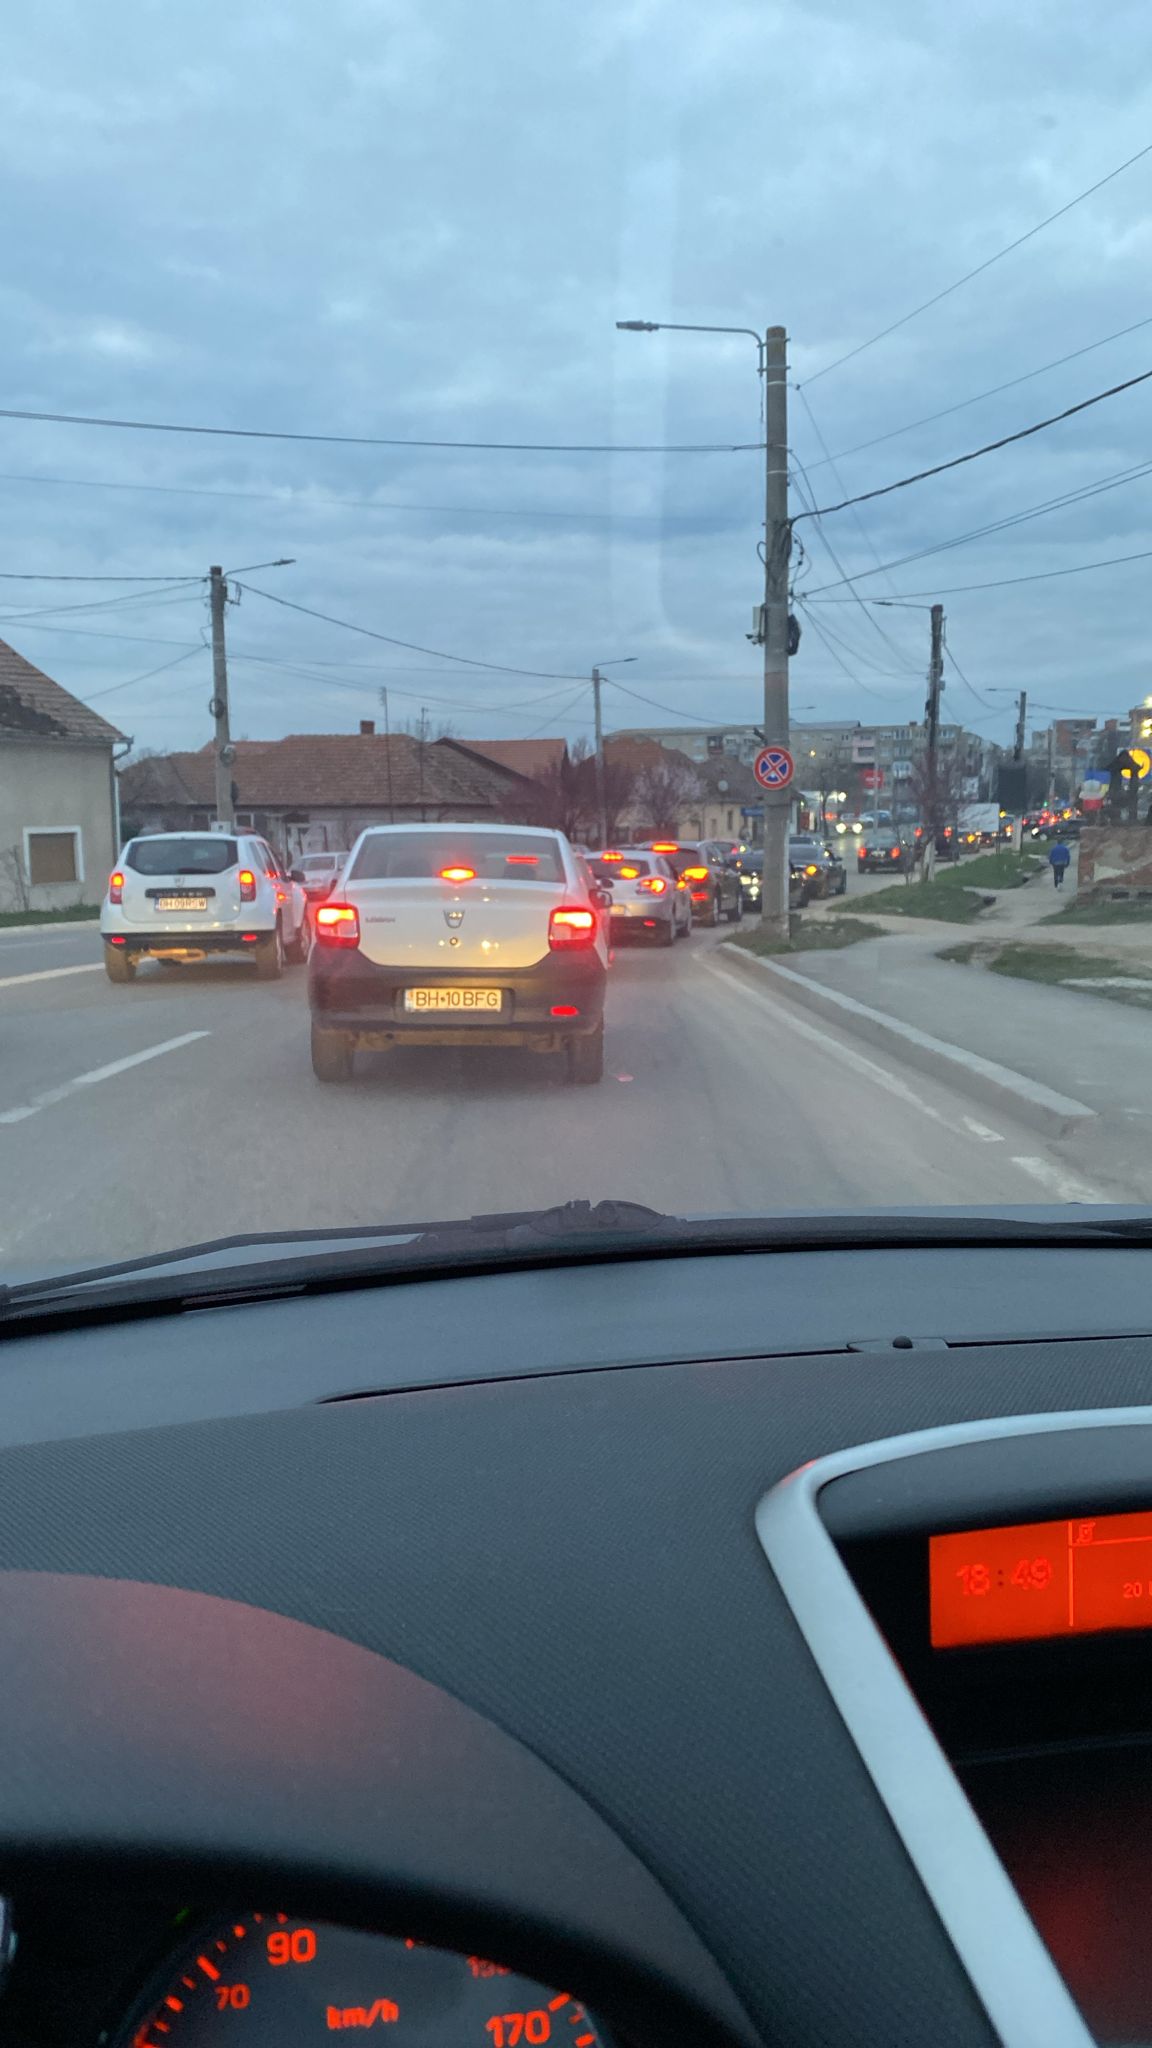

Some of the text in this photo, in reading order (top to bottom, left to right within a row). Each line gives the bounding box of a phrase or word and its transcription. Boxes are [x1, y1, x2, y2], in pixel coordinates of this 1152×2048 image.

[1123, 1582, 1142, 1598] 20
[266, 1928, 317, 1966] 90
[215, 1984, 250, 2011] 70
[326, 1998, 399, 2030] km/h
[486, 2009, 551, 2048] 170
